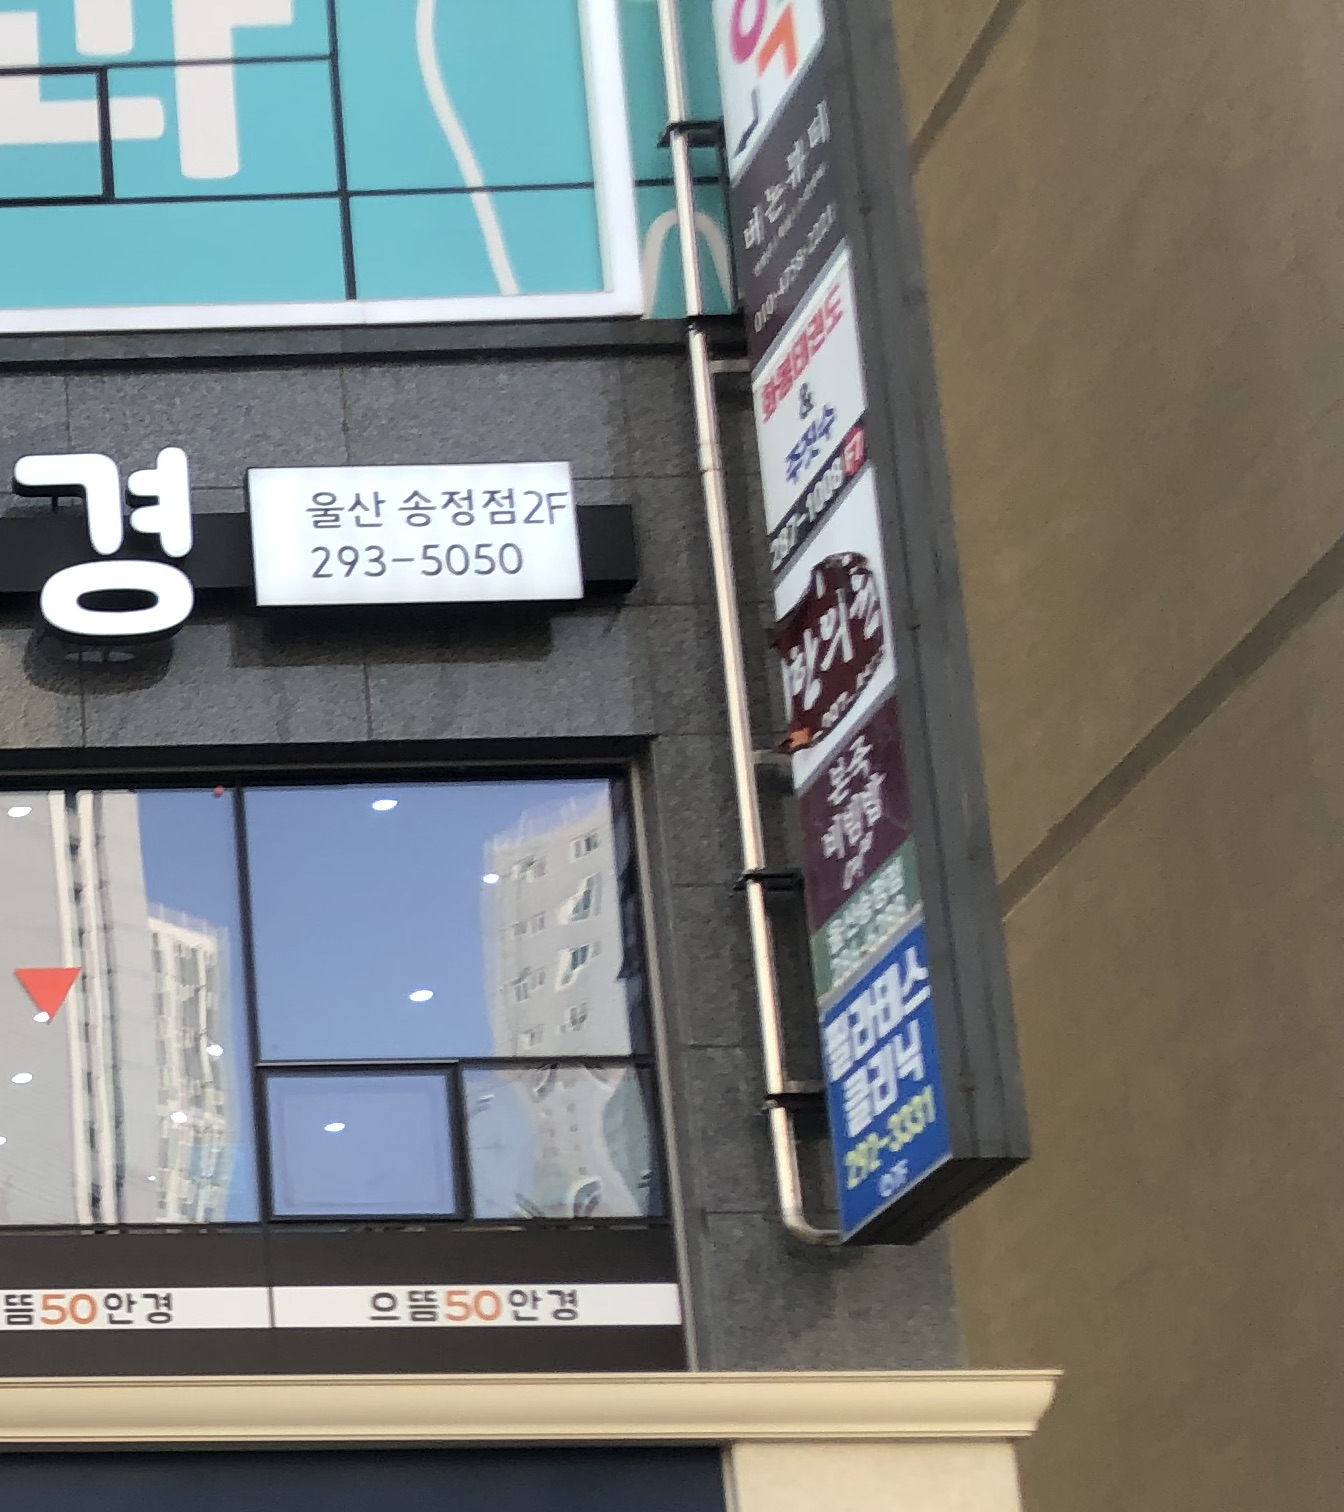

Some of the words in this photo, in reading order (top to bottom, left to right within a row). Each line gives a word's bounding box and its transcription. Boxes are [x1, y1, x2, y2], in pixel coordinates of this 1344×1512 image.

[306, 490, 386, 530] 울산
[310, 543, 524, 580] 293-5050
[369, 1288, 579, 1323] 으뜸50안경
